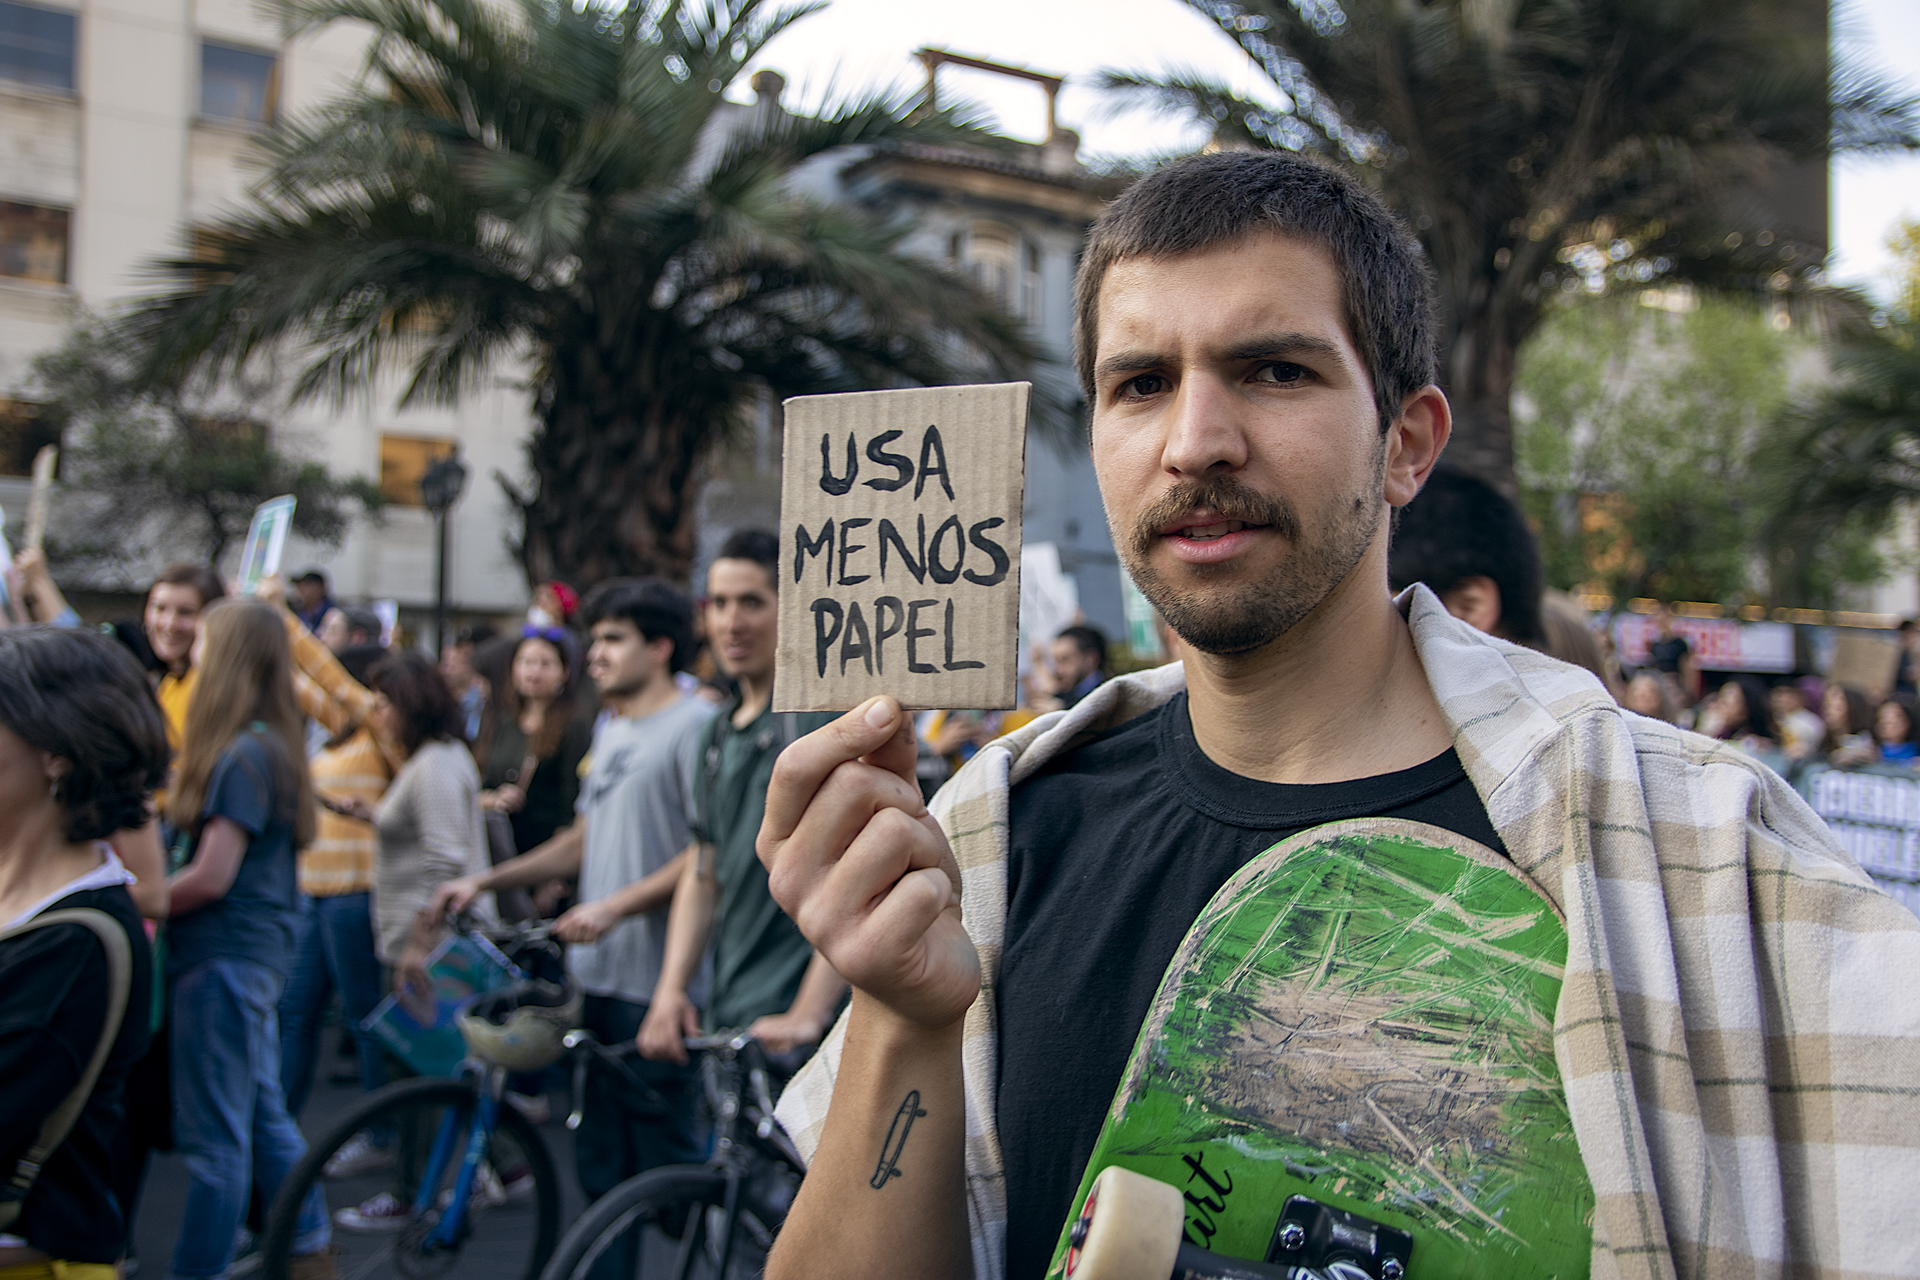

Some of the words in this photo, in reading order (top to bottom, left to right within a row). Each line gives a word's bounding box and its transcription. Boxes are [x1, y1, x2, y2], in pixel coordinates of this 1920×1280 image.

[819, 424, 955, 503] USA
[794, 513, 1011, 588] MENOS
[810, 595, 986, 679] PAPEL
